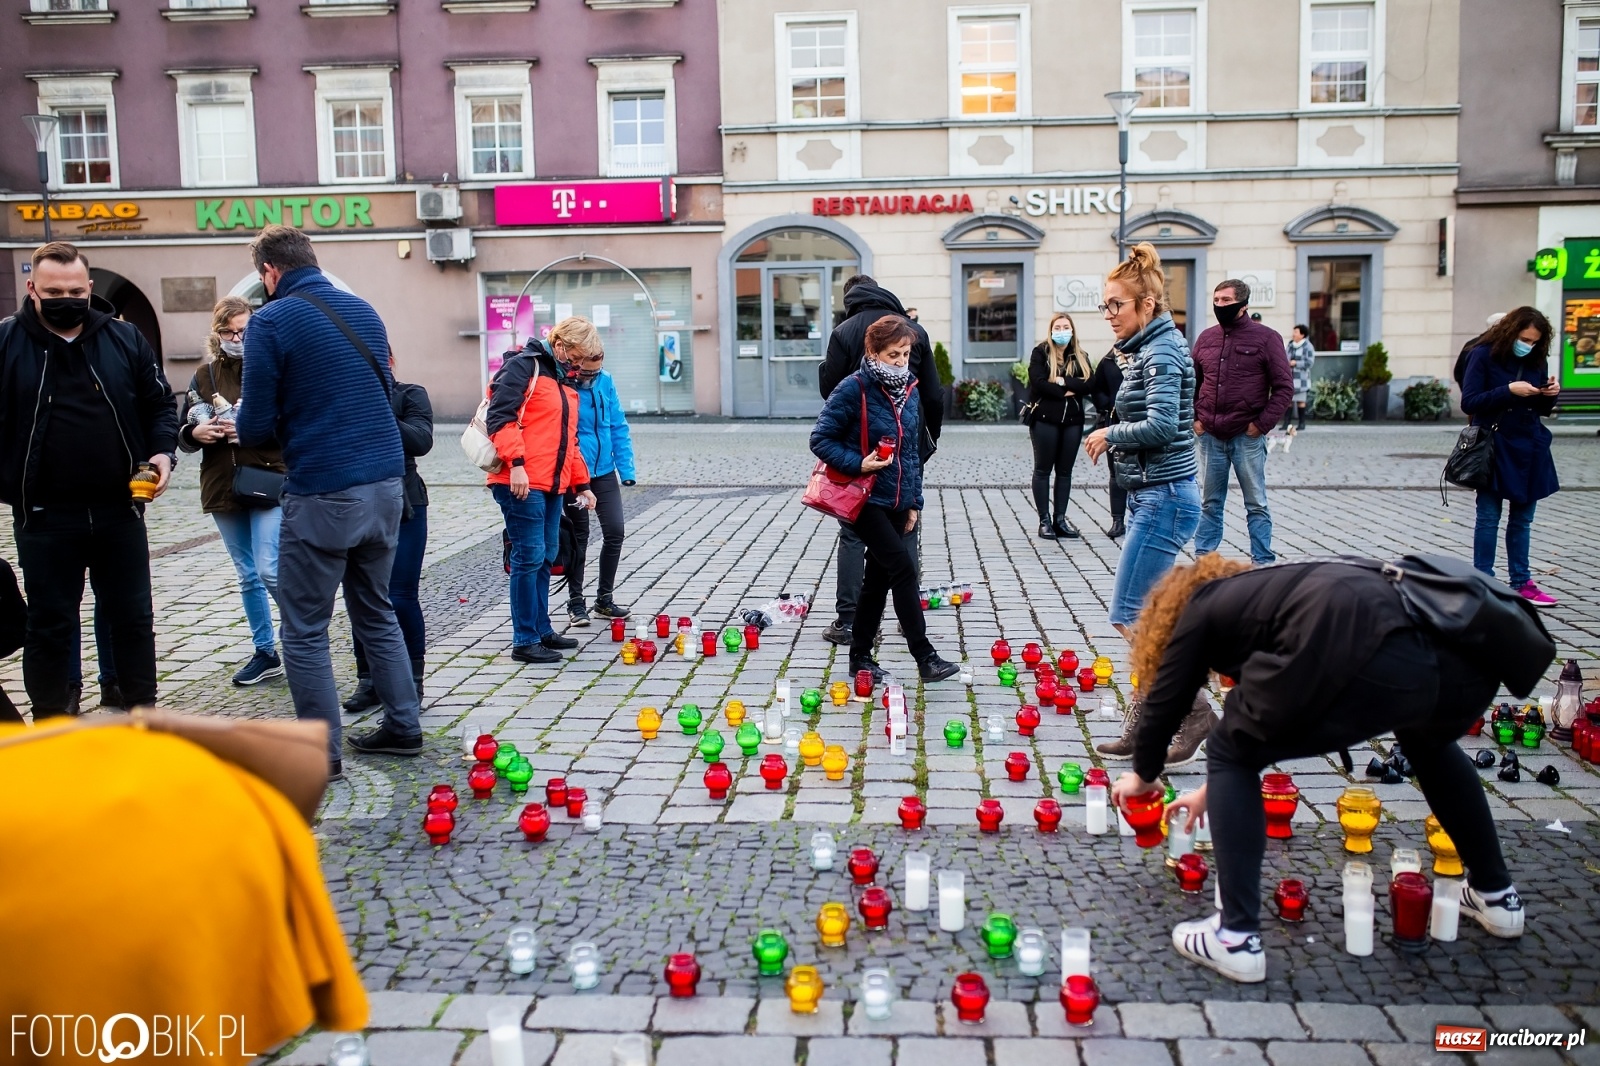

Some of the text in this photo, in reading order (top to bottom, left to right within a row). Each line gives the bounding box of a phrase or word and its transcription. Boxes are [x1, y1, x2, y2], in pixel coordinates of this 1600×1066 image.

[17, 202, 139, 220] TABAC
[195, 196, 374, 230] KANTOR
[812, 186, 1133, 216] RESTAURACJA SHIRO
